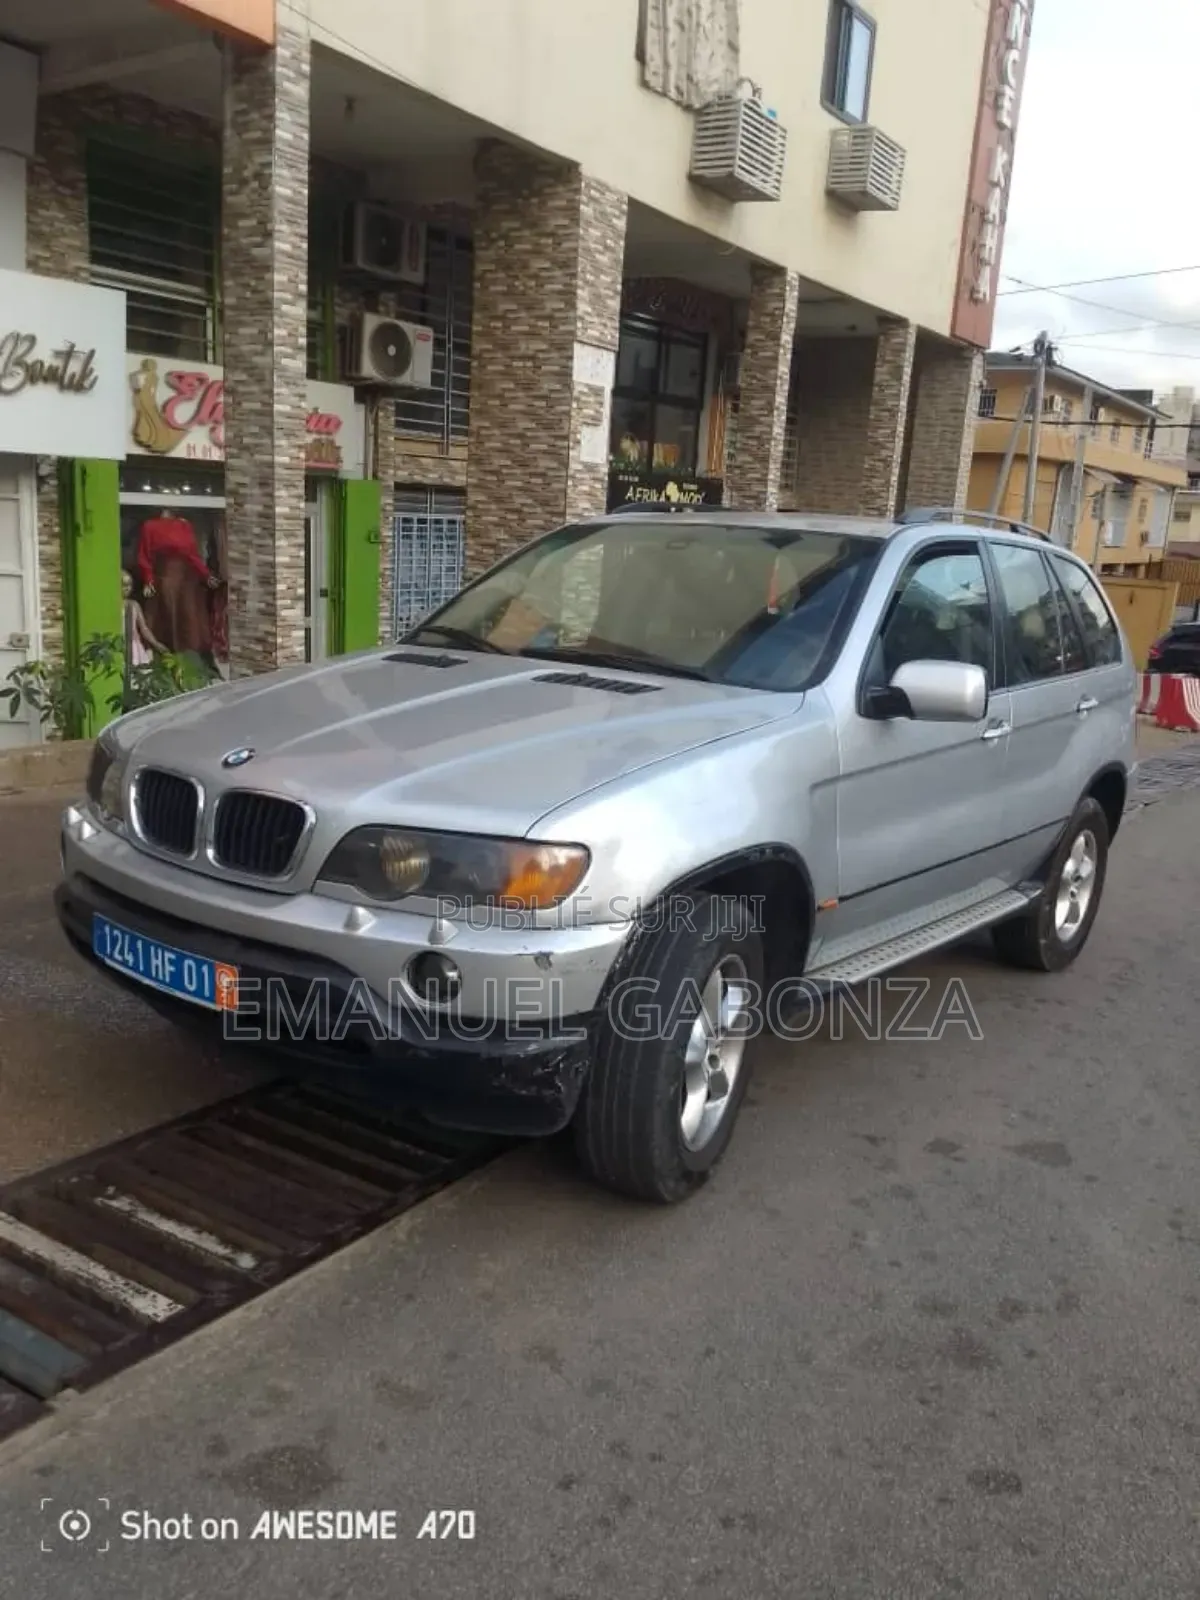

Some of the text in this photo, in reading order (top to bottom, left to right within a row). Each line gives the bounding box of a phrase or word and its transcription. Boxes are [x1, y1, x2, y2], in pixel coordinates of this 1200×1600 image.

[104, 925, 210, 998] 1241 HF 01
